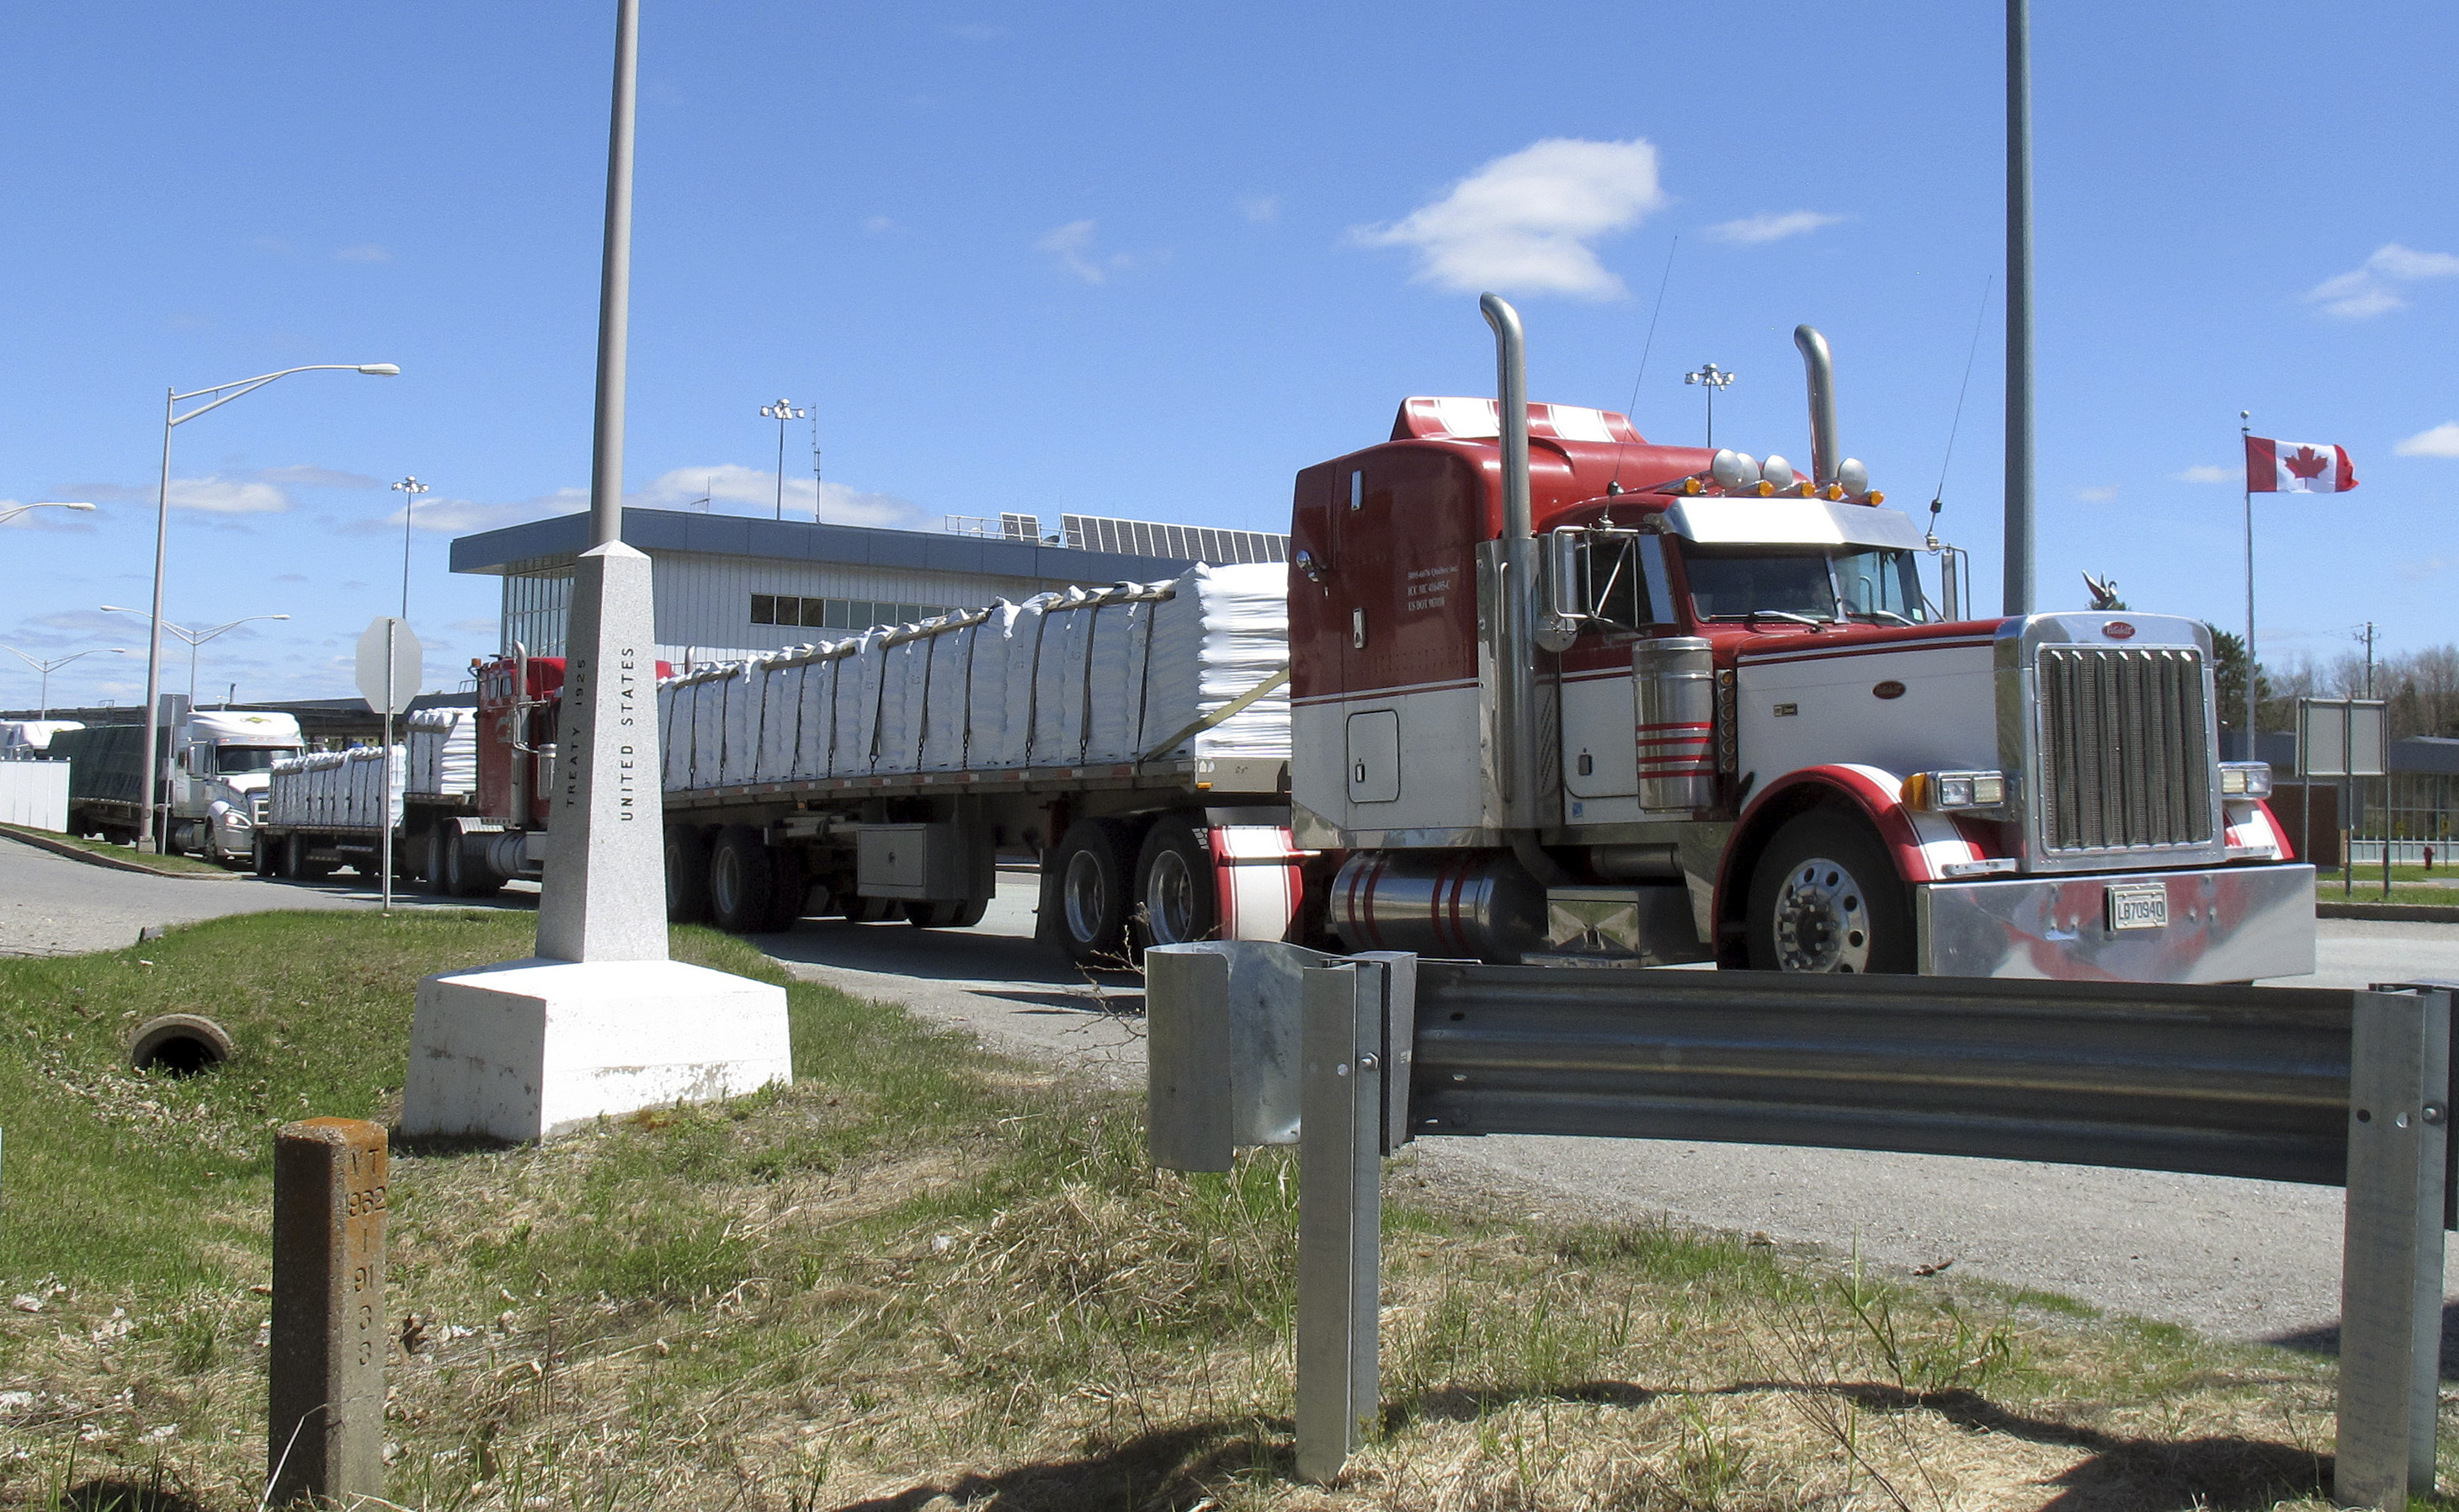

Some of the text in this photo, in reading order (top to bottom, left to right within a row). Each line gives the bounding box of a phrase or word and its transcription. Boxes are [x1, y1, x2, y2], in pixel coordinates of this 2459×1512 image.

[567, 659, 586, 808] TREATY 1925
[621, 647, 634, 821] UNITED STATES
[354, 1264, 374, 1292] 91
